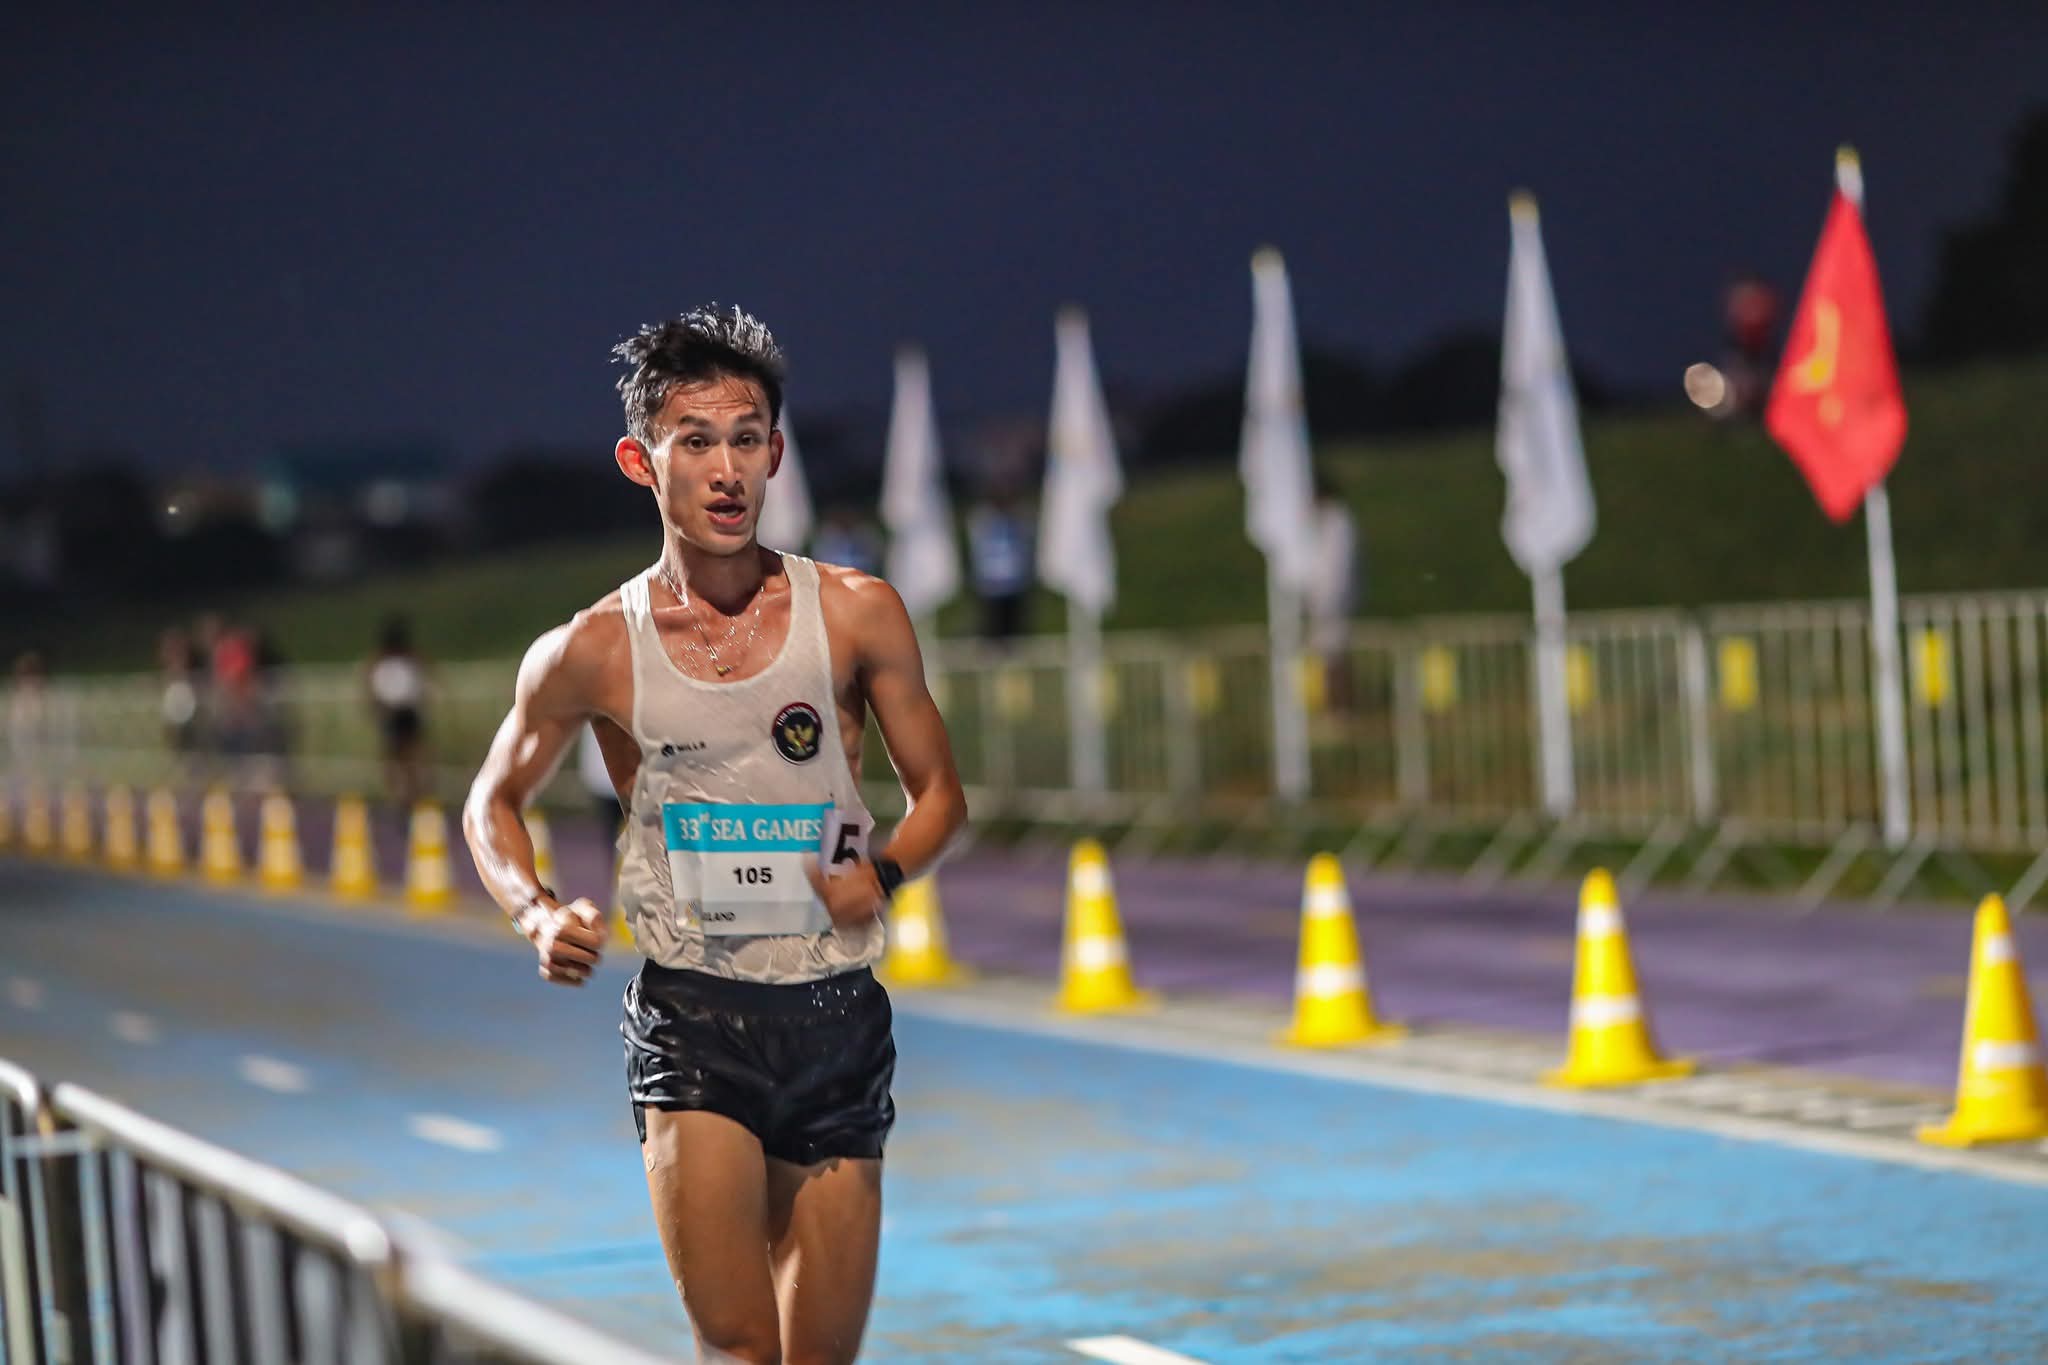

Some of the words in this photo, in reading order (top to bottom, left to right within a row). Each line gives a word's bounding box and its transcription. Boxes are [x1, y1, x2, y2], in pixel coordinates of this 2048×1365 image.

[711, 818, 748, 841] SEA
[752, 818, 823, 841] GAMES
[733, 867, 773, 884] 105
